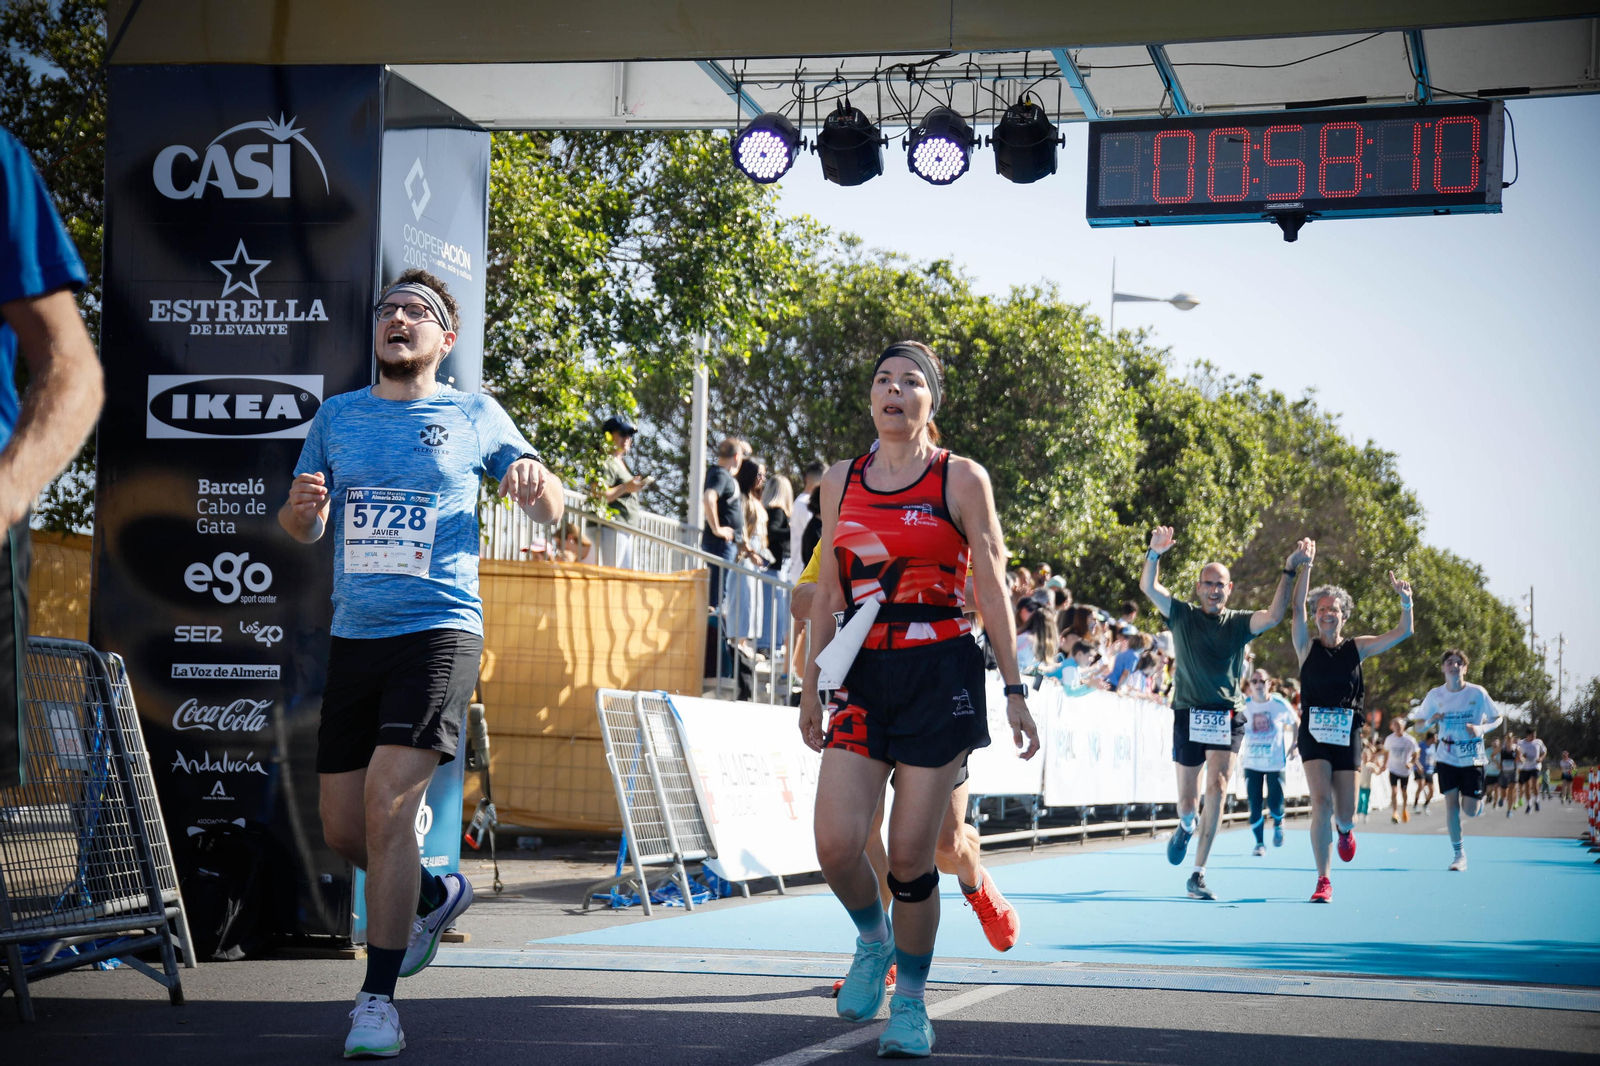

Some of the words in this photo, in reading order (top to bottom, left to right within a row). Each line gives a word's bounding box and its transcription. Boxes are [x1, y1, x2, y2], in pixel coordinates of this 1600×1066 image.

[152, 143, 291, 200] CASI
[403, 223, 471, 271] COOPERACIÓN
[403, 244, 428, 270] 2005
[149, 299, 329, 322] ESTRELLA
[189, 324, 212, 336] DE
[214, 324, 288, 336] LEVANTE
[171, 393, 302, 420] IKEA
[197, 478, 265, 495] Barceló
[196, 498, 240, 515] Cabo
[245, 498, 267, 515] de
[196, 517, 237, 534] Gata
[352, 504, 427, 531] 5728
[183, 551, 273, 604] ego
[240, 595, 257, 605] sport
[257, 595, 278, 603] center
[174, 625, 223, 643] SER
[173, 666, 188, 677] La
[189, 666, 212, 677] Voz
[213, 666, 229, 678] de
[229, 666, 279, 678] Almería
[172, 697, 274, 732] Coca-Cola
[1194, 714, 1226, 726] 5536
[1314, 713, 1349, 726] 5535
[171, 749, 269, 776] Andalucía
